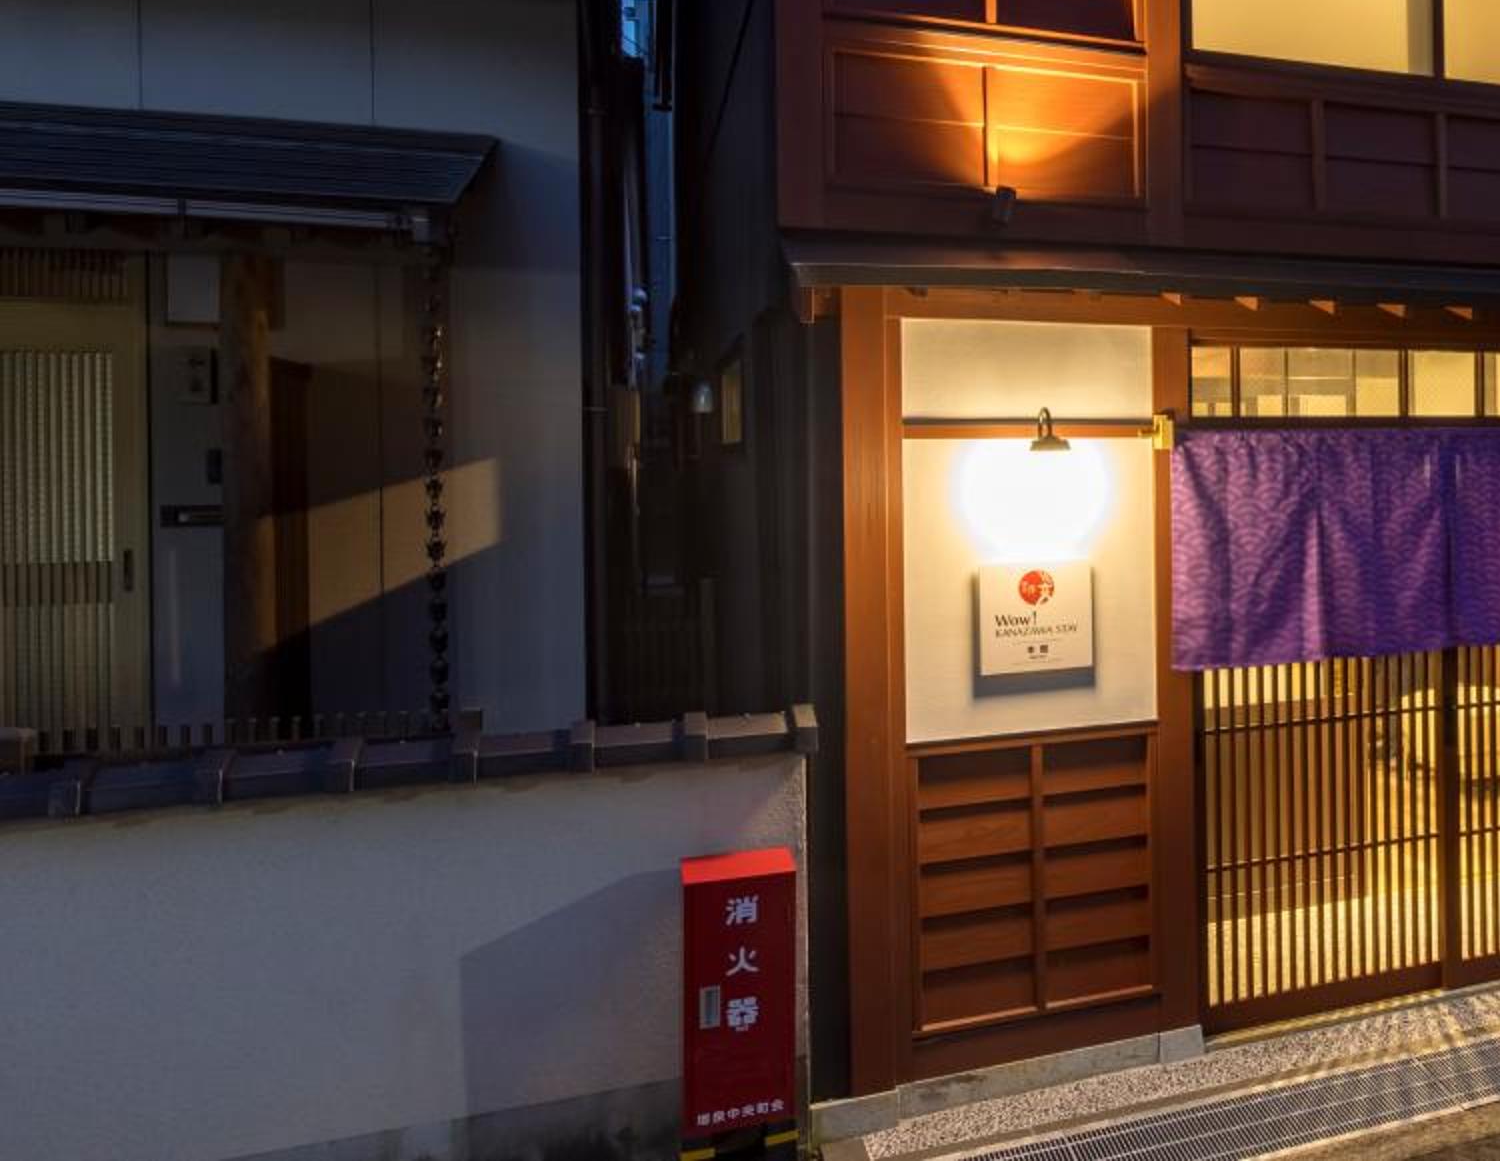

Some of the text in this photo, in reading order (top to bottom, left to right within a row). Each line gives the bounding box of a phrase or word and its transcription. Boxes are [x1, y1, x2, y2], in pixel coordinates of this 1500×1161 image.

[995, 611, 1036, 626] Wow!
[995, 624, 1077, 637] KANAZAWA STAY
[725, 894, 760, 1027] 消火器
